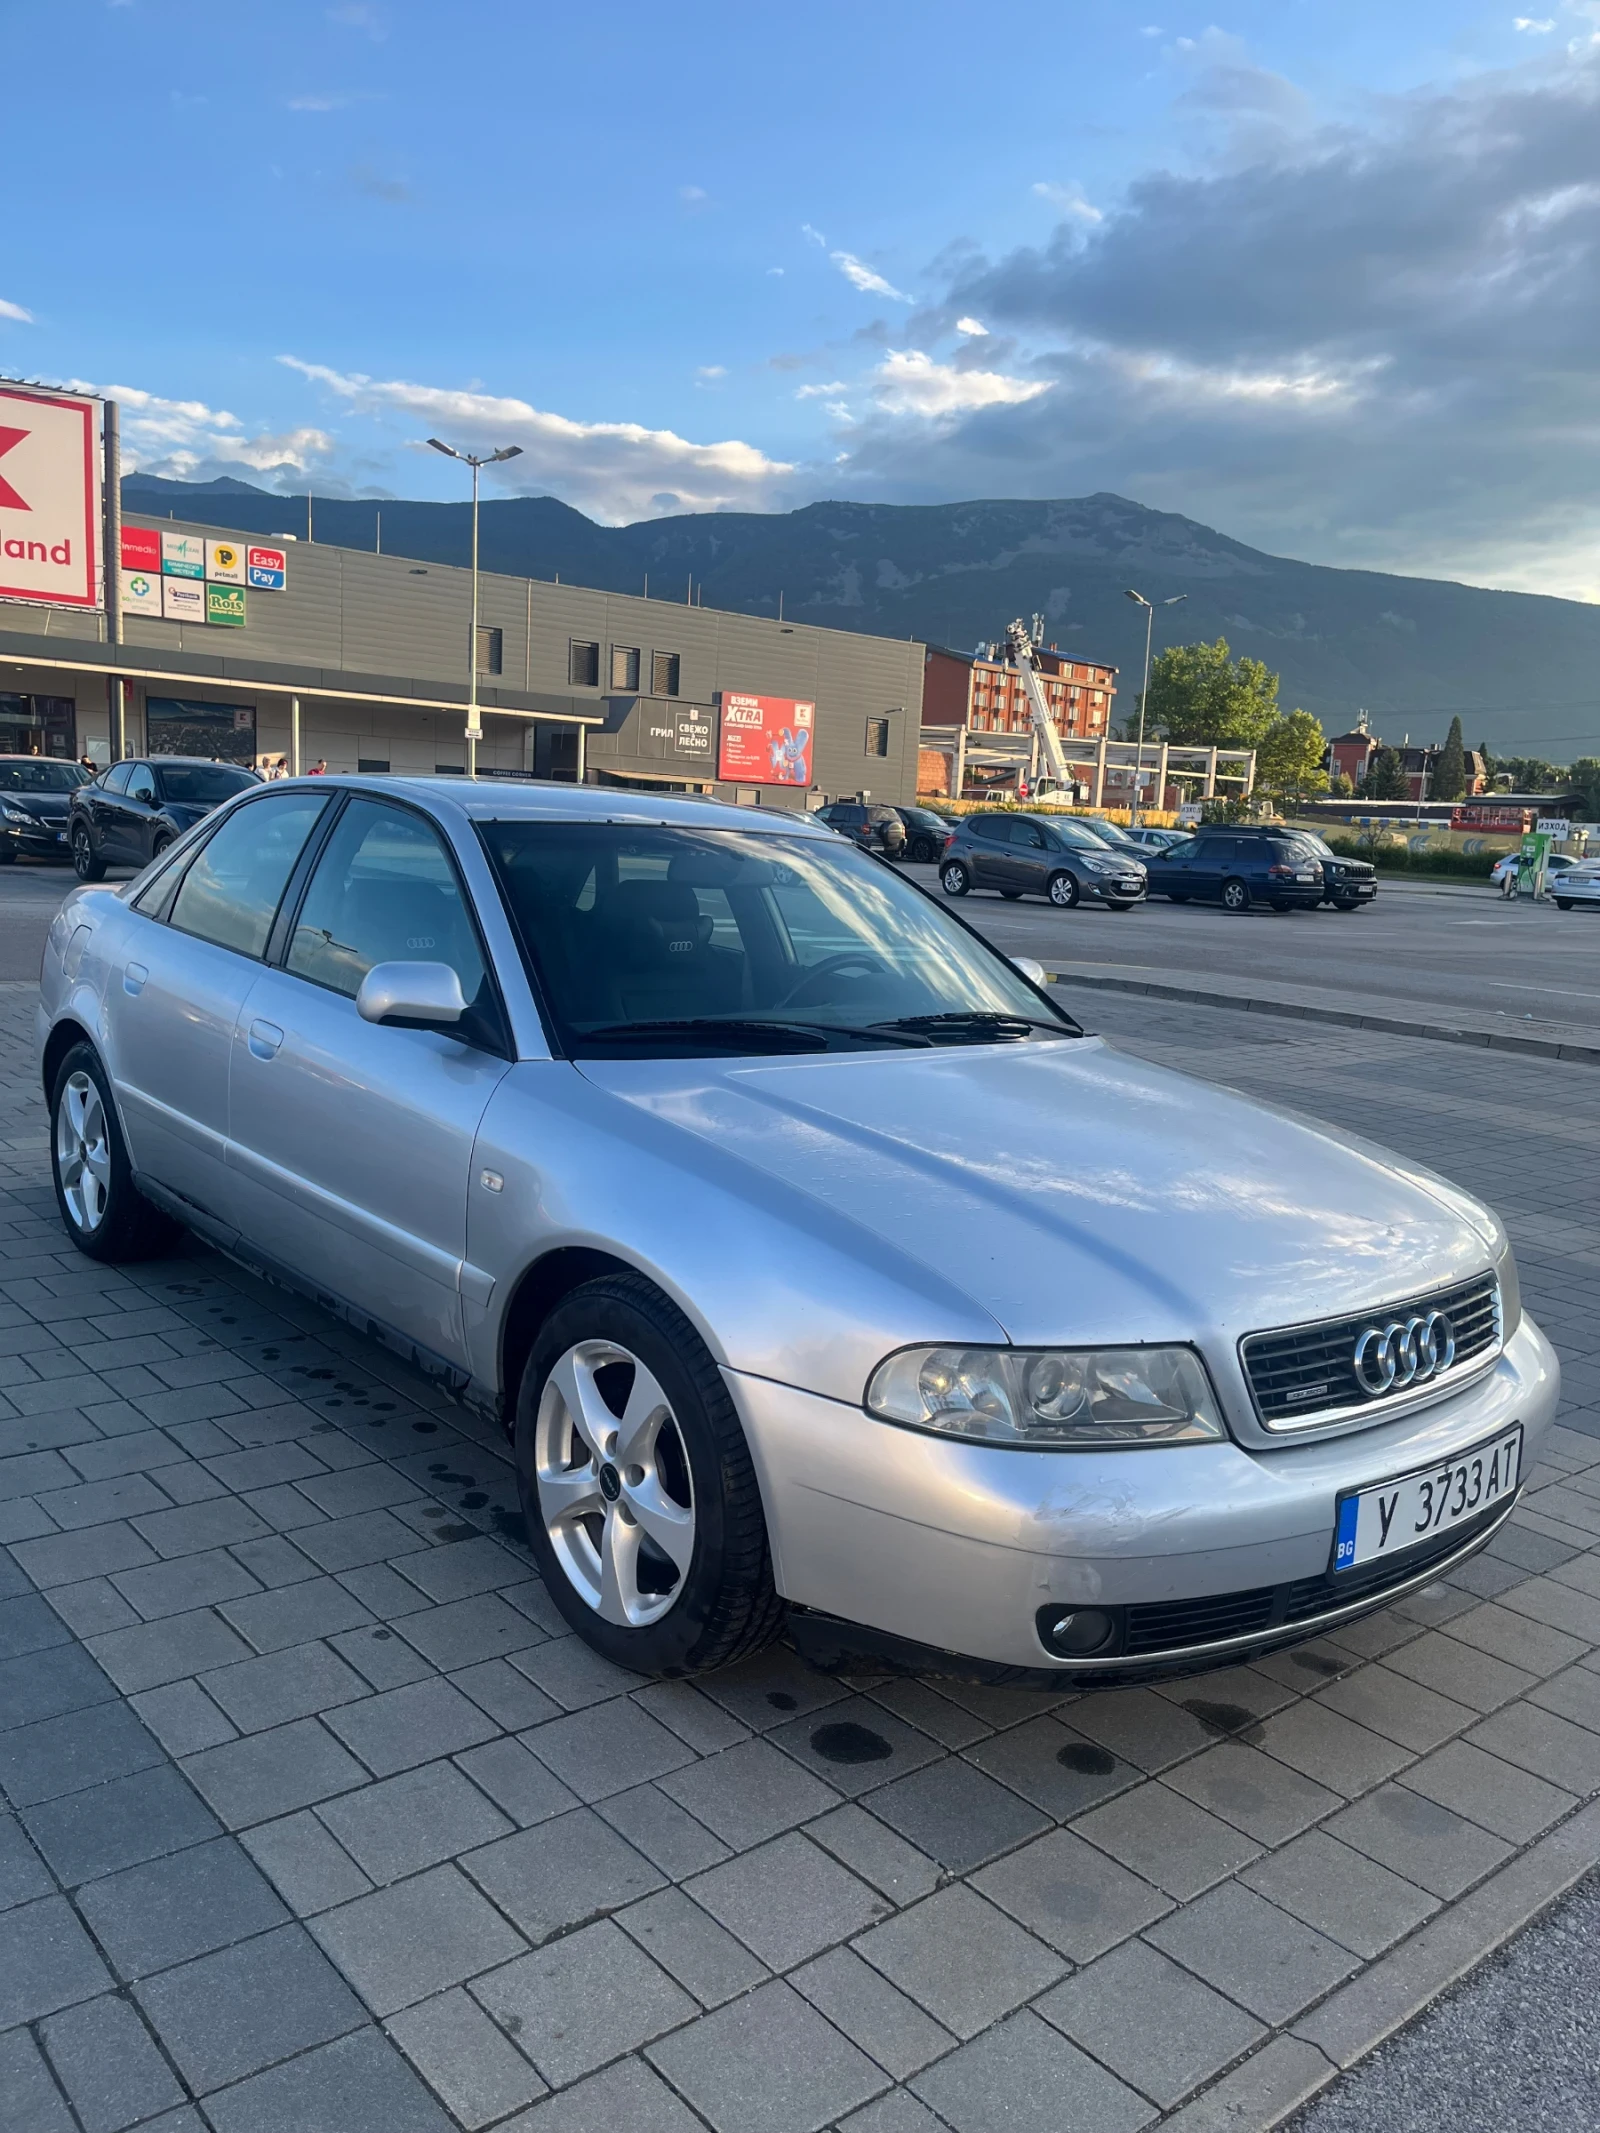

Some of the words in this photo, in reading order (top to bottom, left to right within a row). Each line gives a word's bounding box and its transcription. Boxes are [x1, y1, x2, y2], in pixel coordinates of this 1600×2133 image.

[0, 529, 71, 566] and
[253, 552, 280, 569] Easy
[214, 571, 238, 579] petmall
[253, 569, 275, 585] Pay
[210, 594, 244, 612] Rois
[730, 695, 759, 707] ВЗЕМИ
[724, 705, 763, 725] XTRA
[650, 727, 674, 739] ГРИЛ
[678, 723, 709, 735] СВЕЖО
[678, 736, 708, 747] ЛЕСНО
[1538, 822, 1567, 832] ИЗХОД
[1415, 1459, 1482, 1532] 3733
[1337, 1540, 1354, 1559] BG
